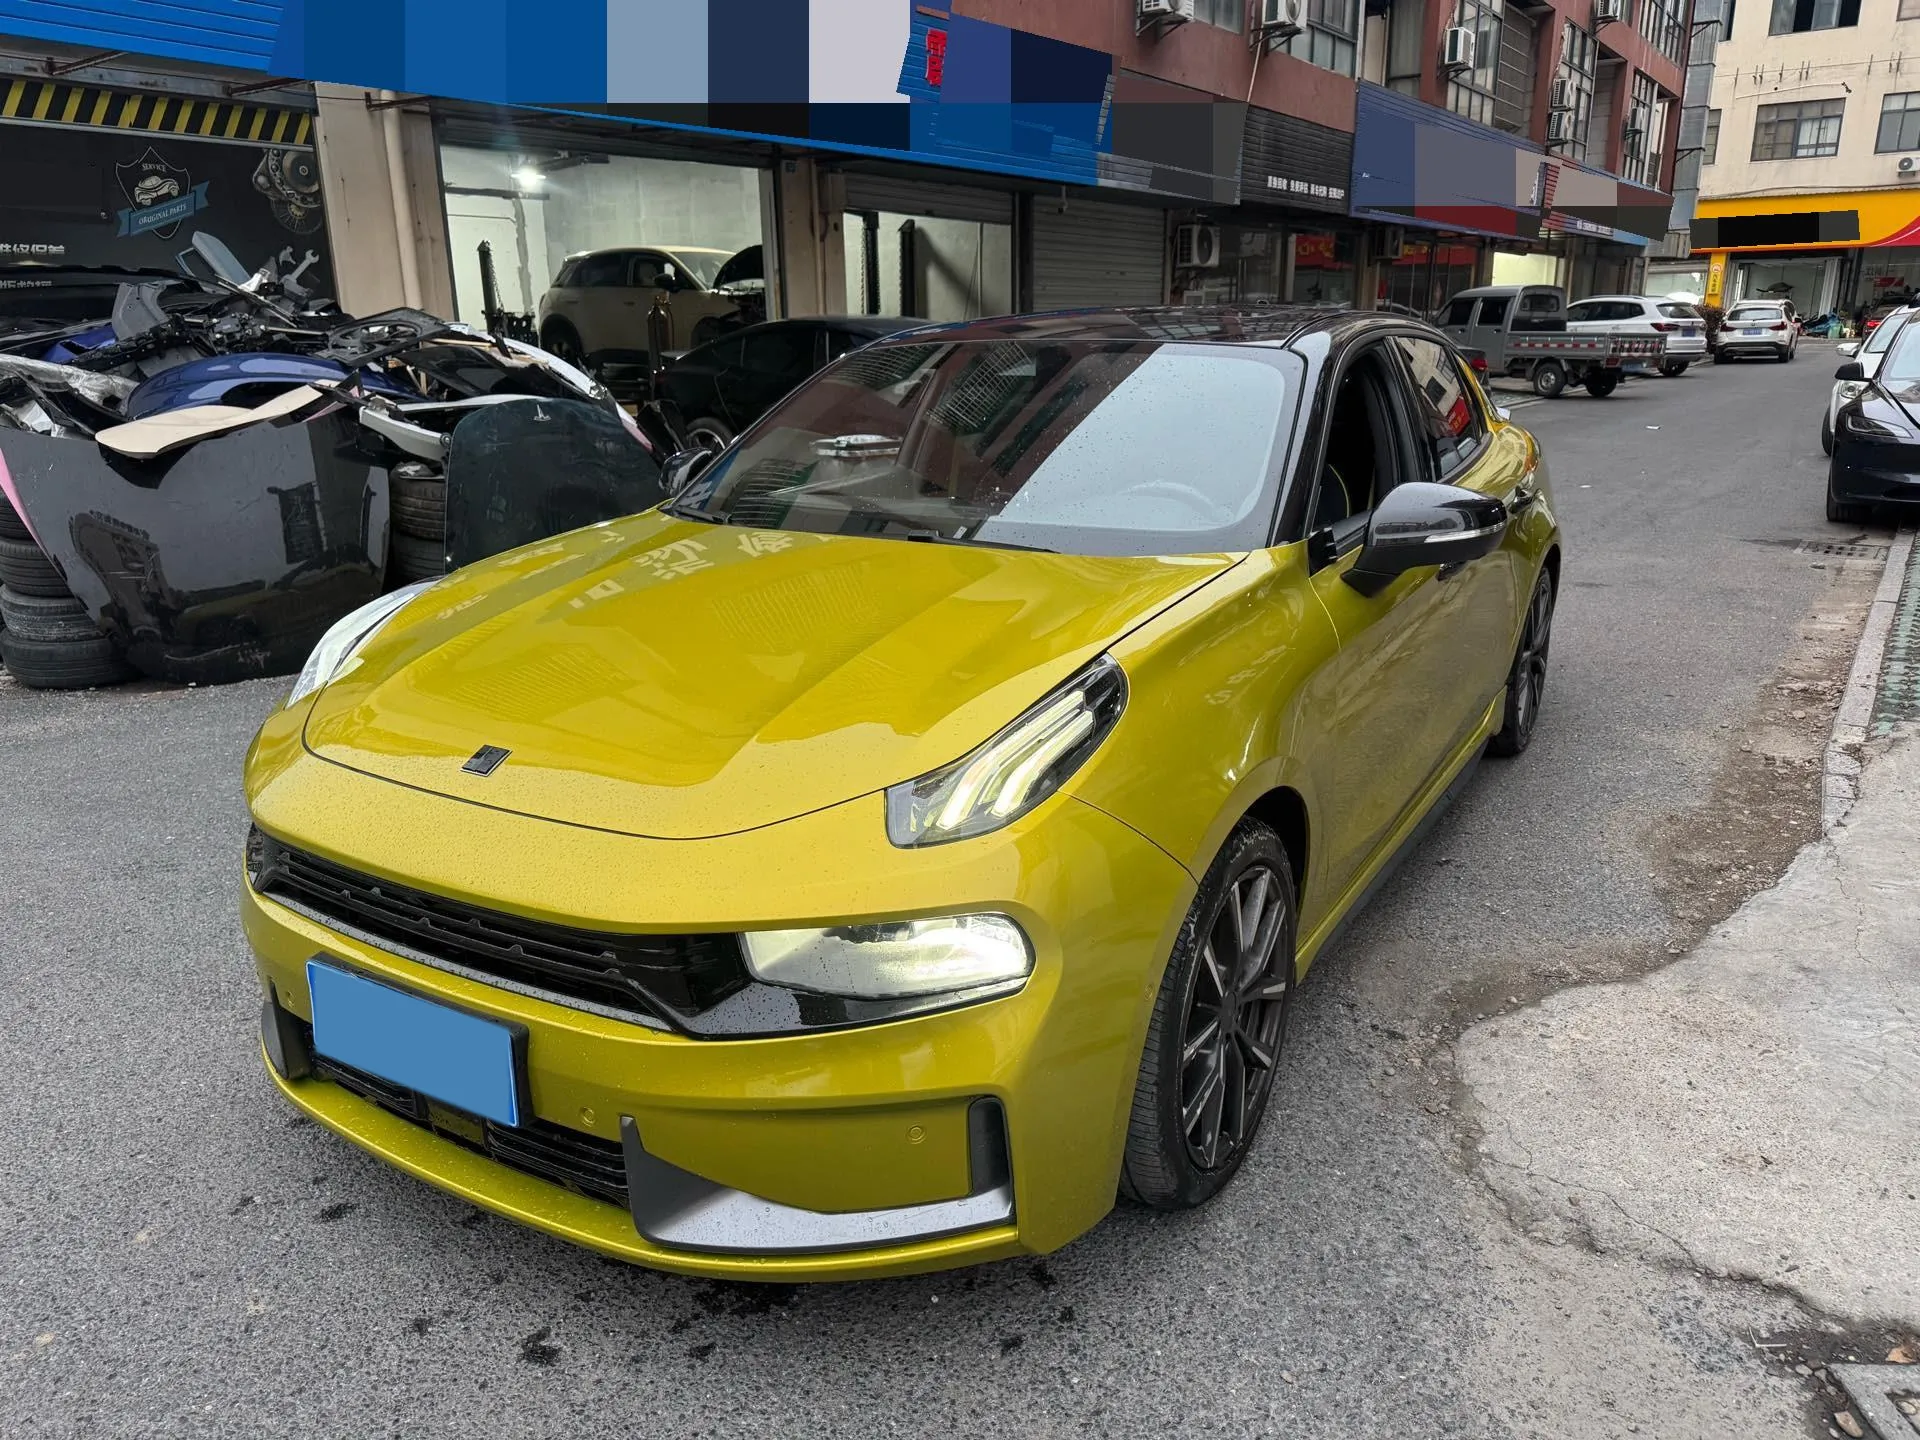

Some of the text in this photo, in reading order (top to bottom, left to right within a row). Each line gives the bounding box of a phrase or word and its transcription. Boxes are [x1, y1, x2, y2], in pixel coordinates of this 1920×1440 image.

[142, 163, 167, 173] SERVICE
[138, 203, 187, 225] ORIGINAL PARTS
